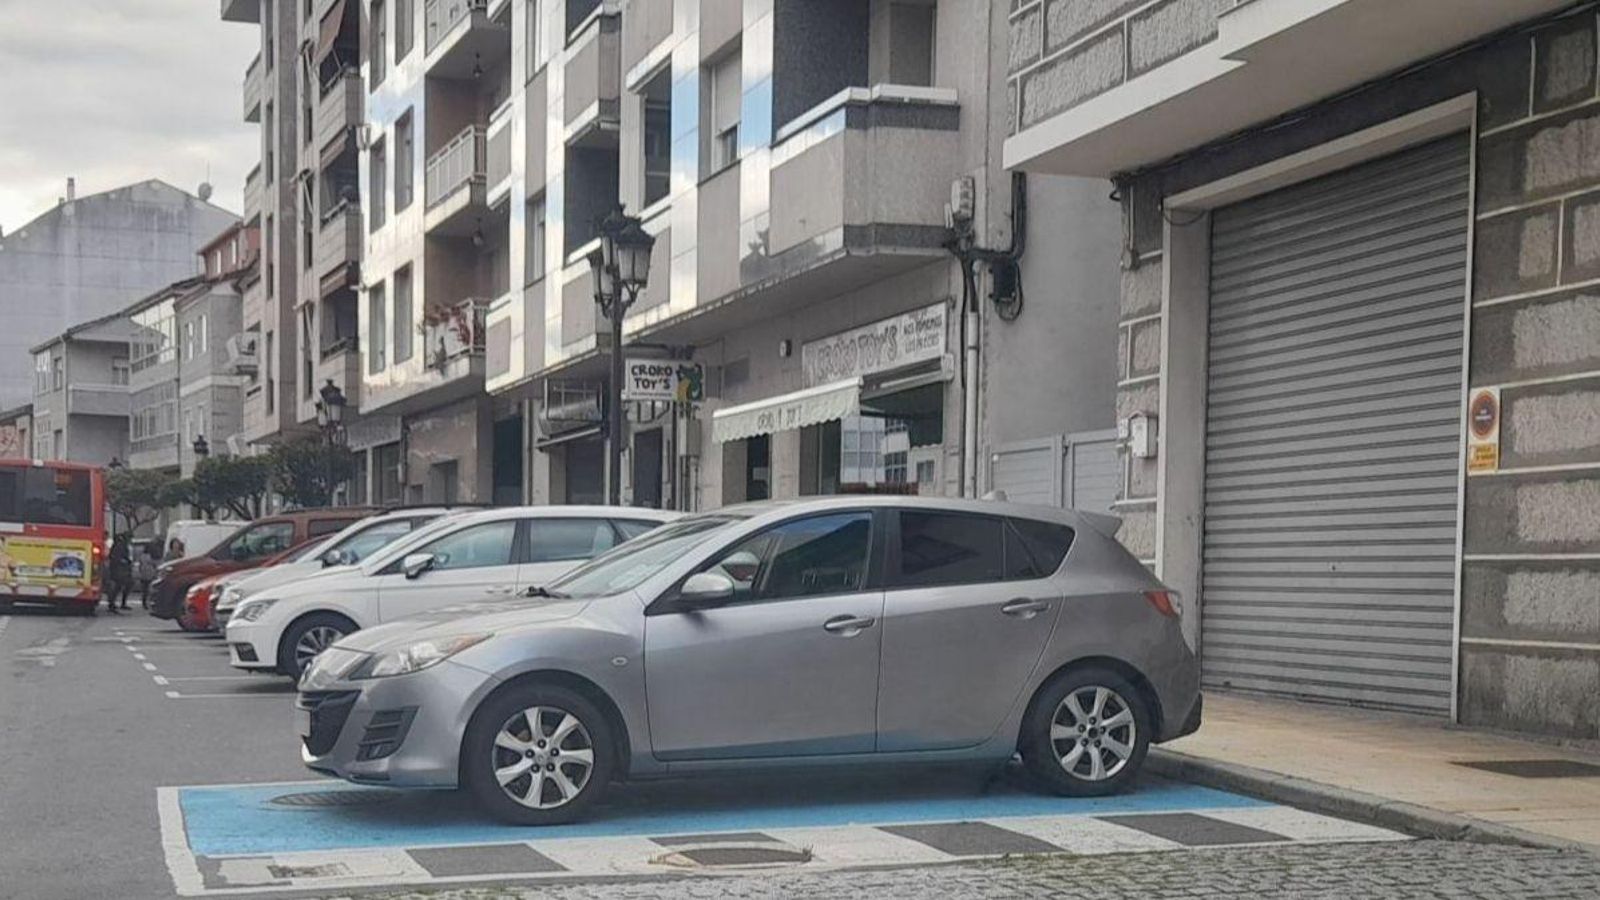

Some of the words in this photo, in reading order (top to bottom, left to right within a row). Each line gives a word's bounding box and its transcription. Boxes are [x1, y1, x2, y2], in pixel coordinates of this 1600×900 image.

[858, 324, 898, 369] TOY'S
[631, 364, 673, 376] CROKO
[634, 378, 670, 390] TOY'S
